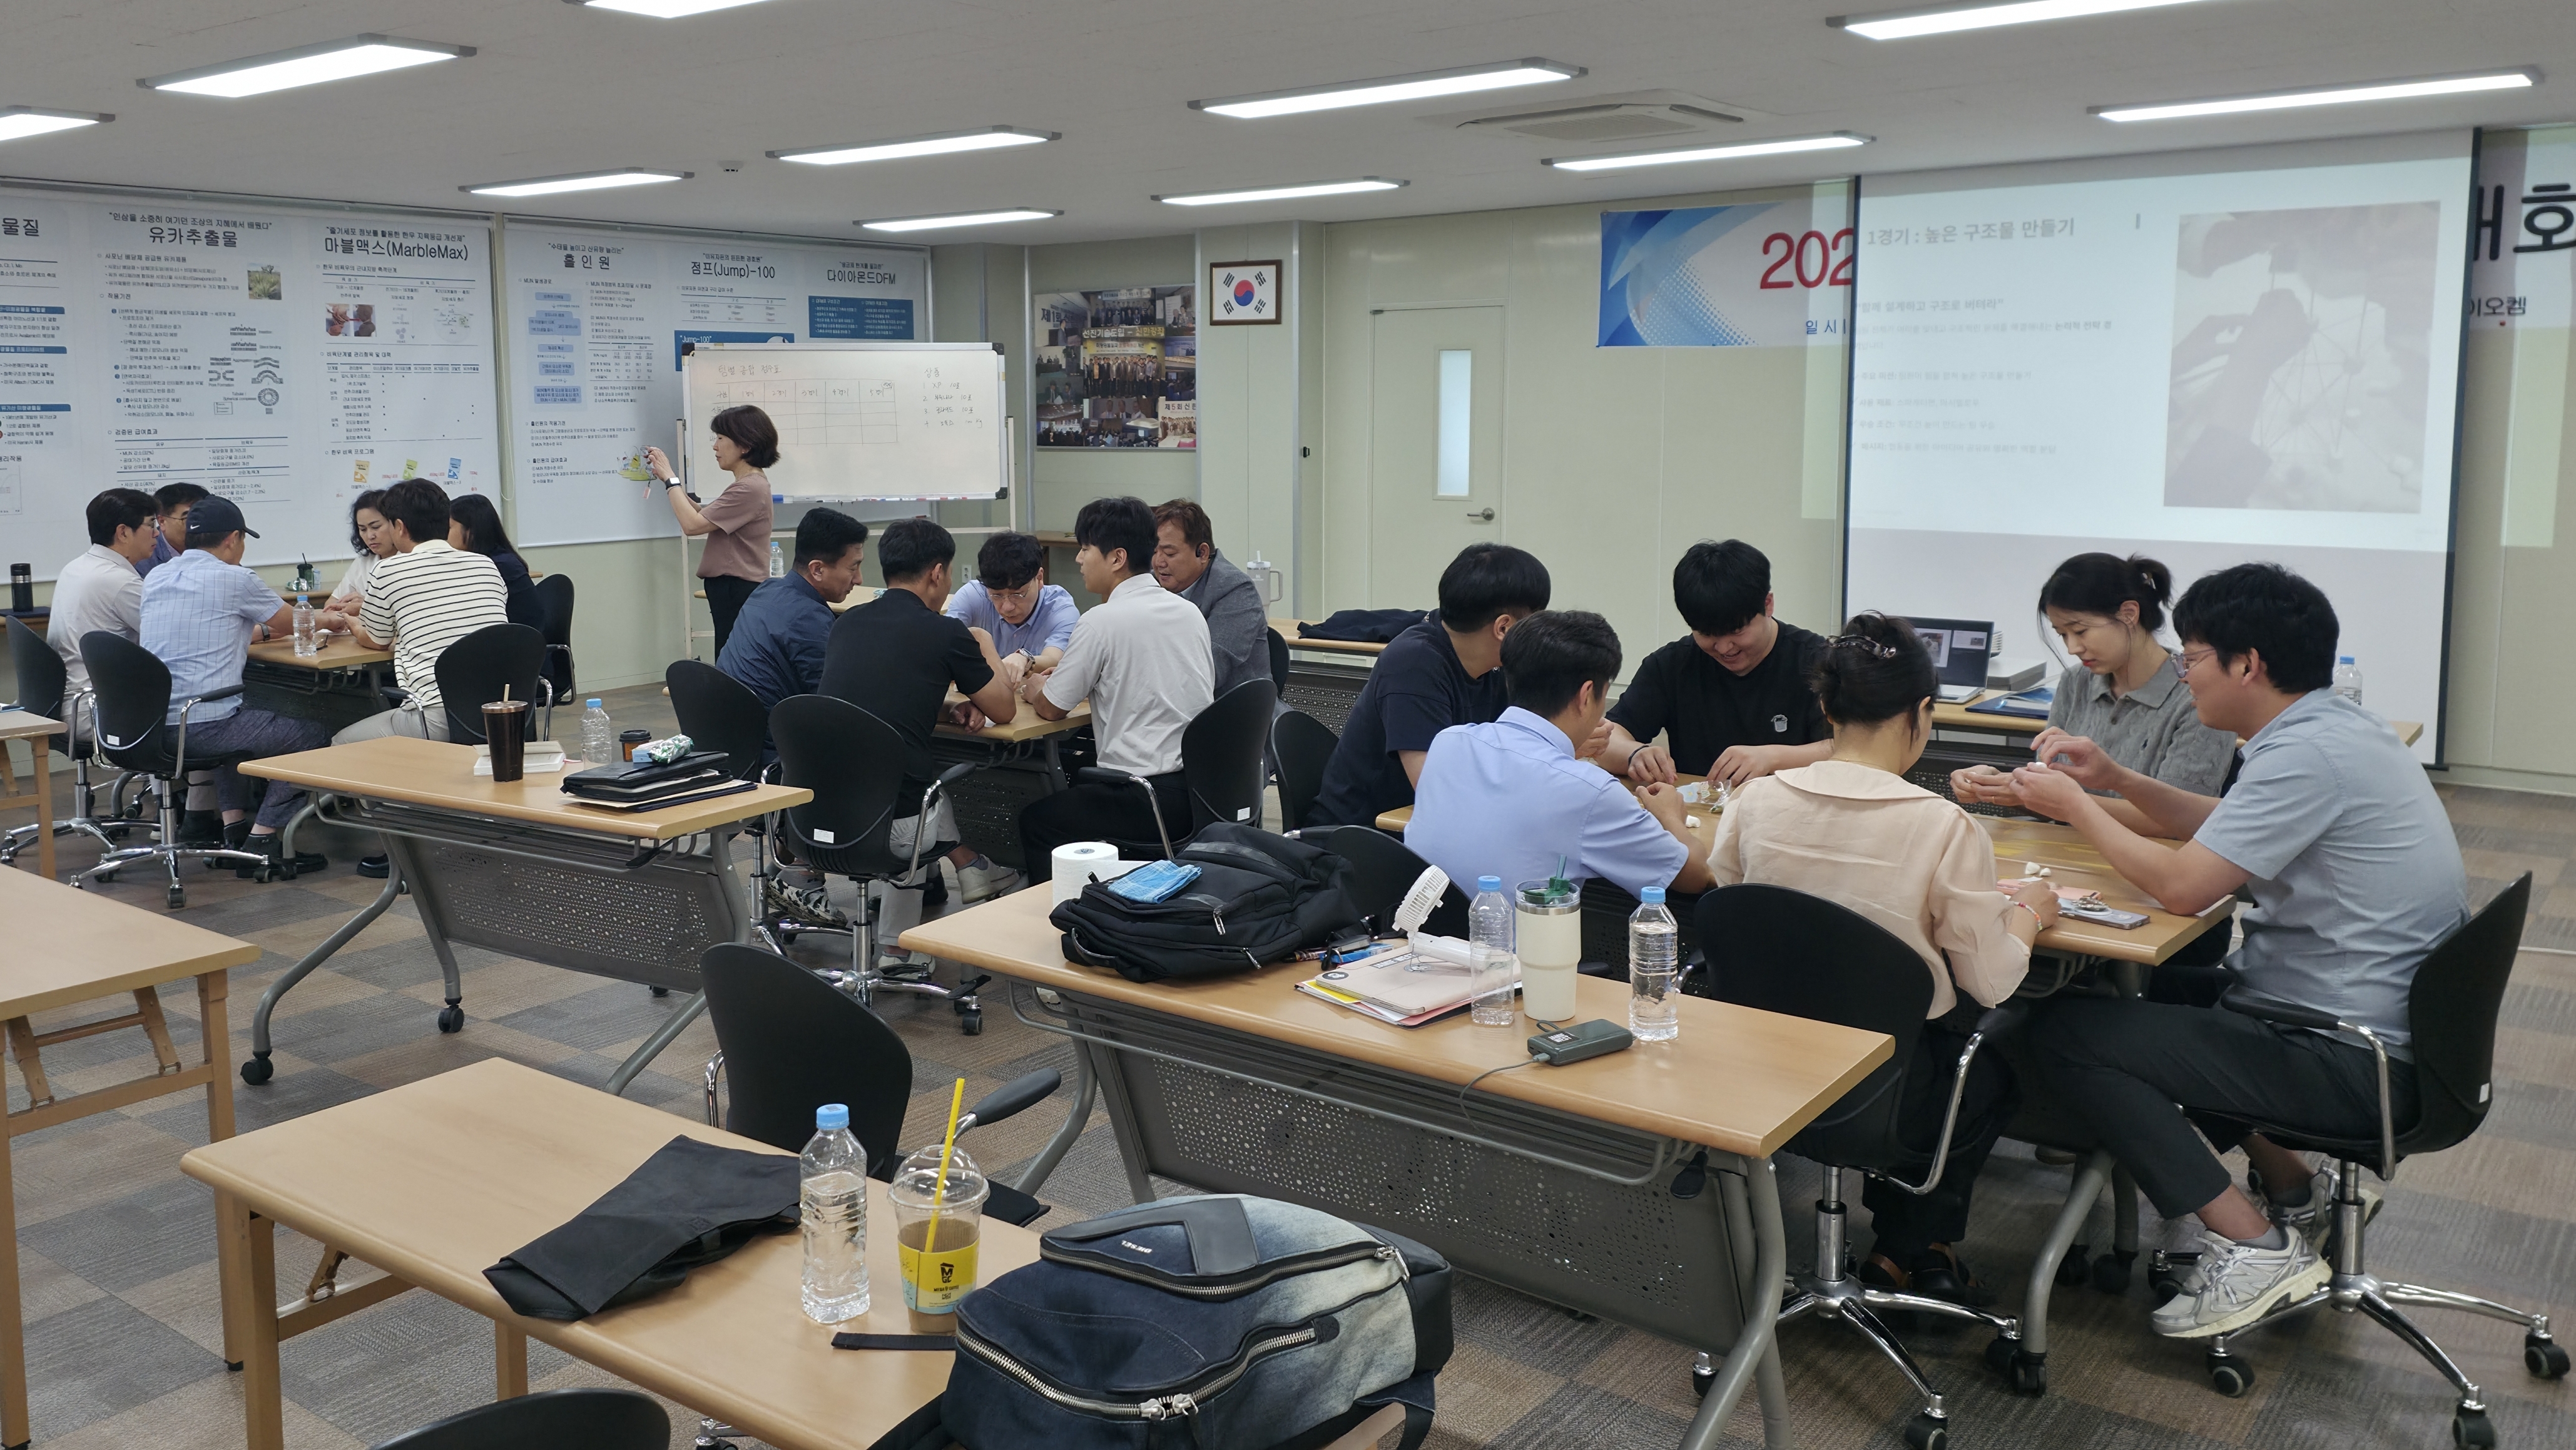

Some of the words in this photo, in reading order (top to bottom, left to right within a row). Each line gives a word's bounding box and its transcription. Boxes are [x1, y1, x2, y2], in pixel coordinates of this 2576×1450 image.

[1, 217, 39, 237] 물질
[140, 215, 163, 223] 소중히
[166, 217, 188, 225] 여기던
[150, 227, 238, 247] 유카추출물
[1868, 228, 1909, 245] 1경기
[1925, 225, 1958, 243] 높은
[1963, 221, 2015, 241] 구조물
[2022, 217, 2075, 237] 만들기
[325, 237, 468, 261] 마블맥스(MarbleMax)
[691, 262, 775, 278] 점프(Jump)-100
[827, 269, 895, 284] 다이아몬드DFM
[1082, 329, 1124, 338] 선진기술도입
[718, 365, 735, 377] 팀별
[740, 364, 755, 375] 종합
[761, 365, 781, 374] 점수표
[924, 367, 939, 378] 상품
[1121, 1240, 1152, 1253] DIESEL
